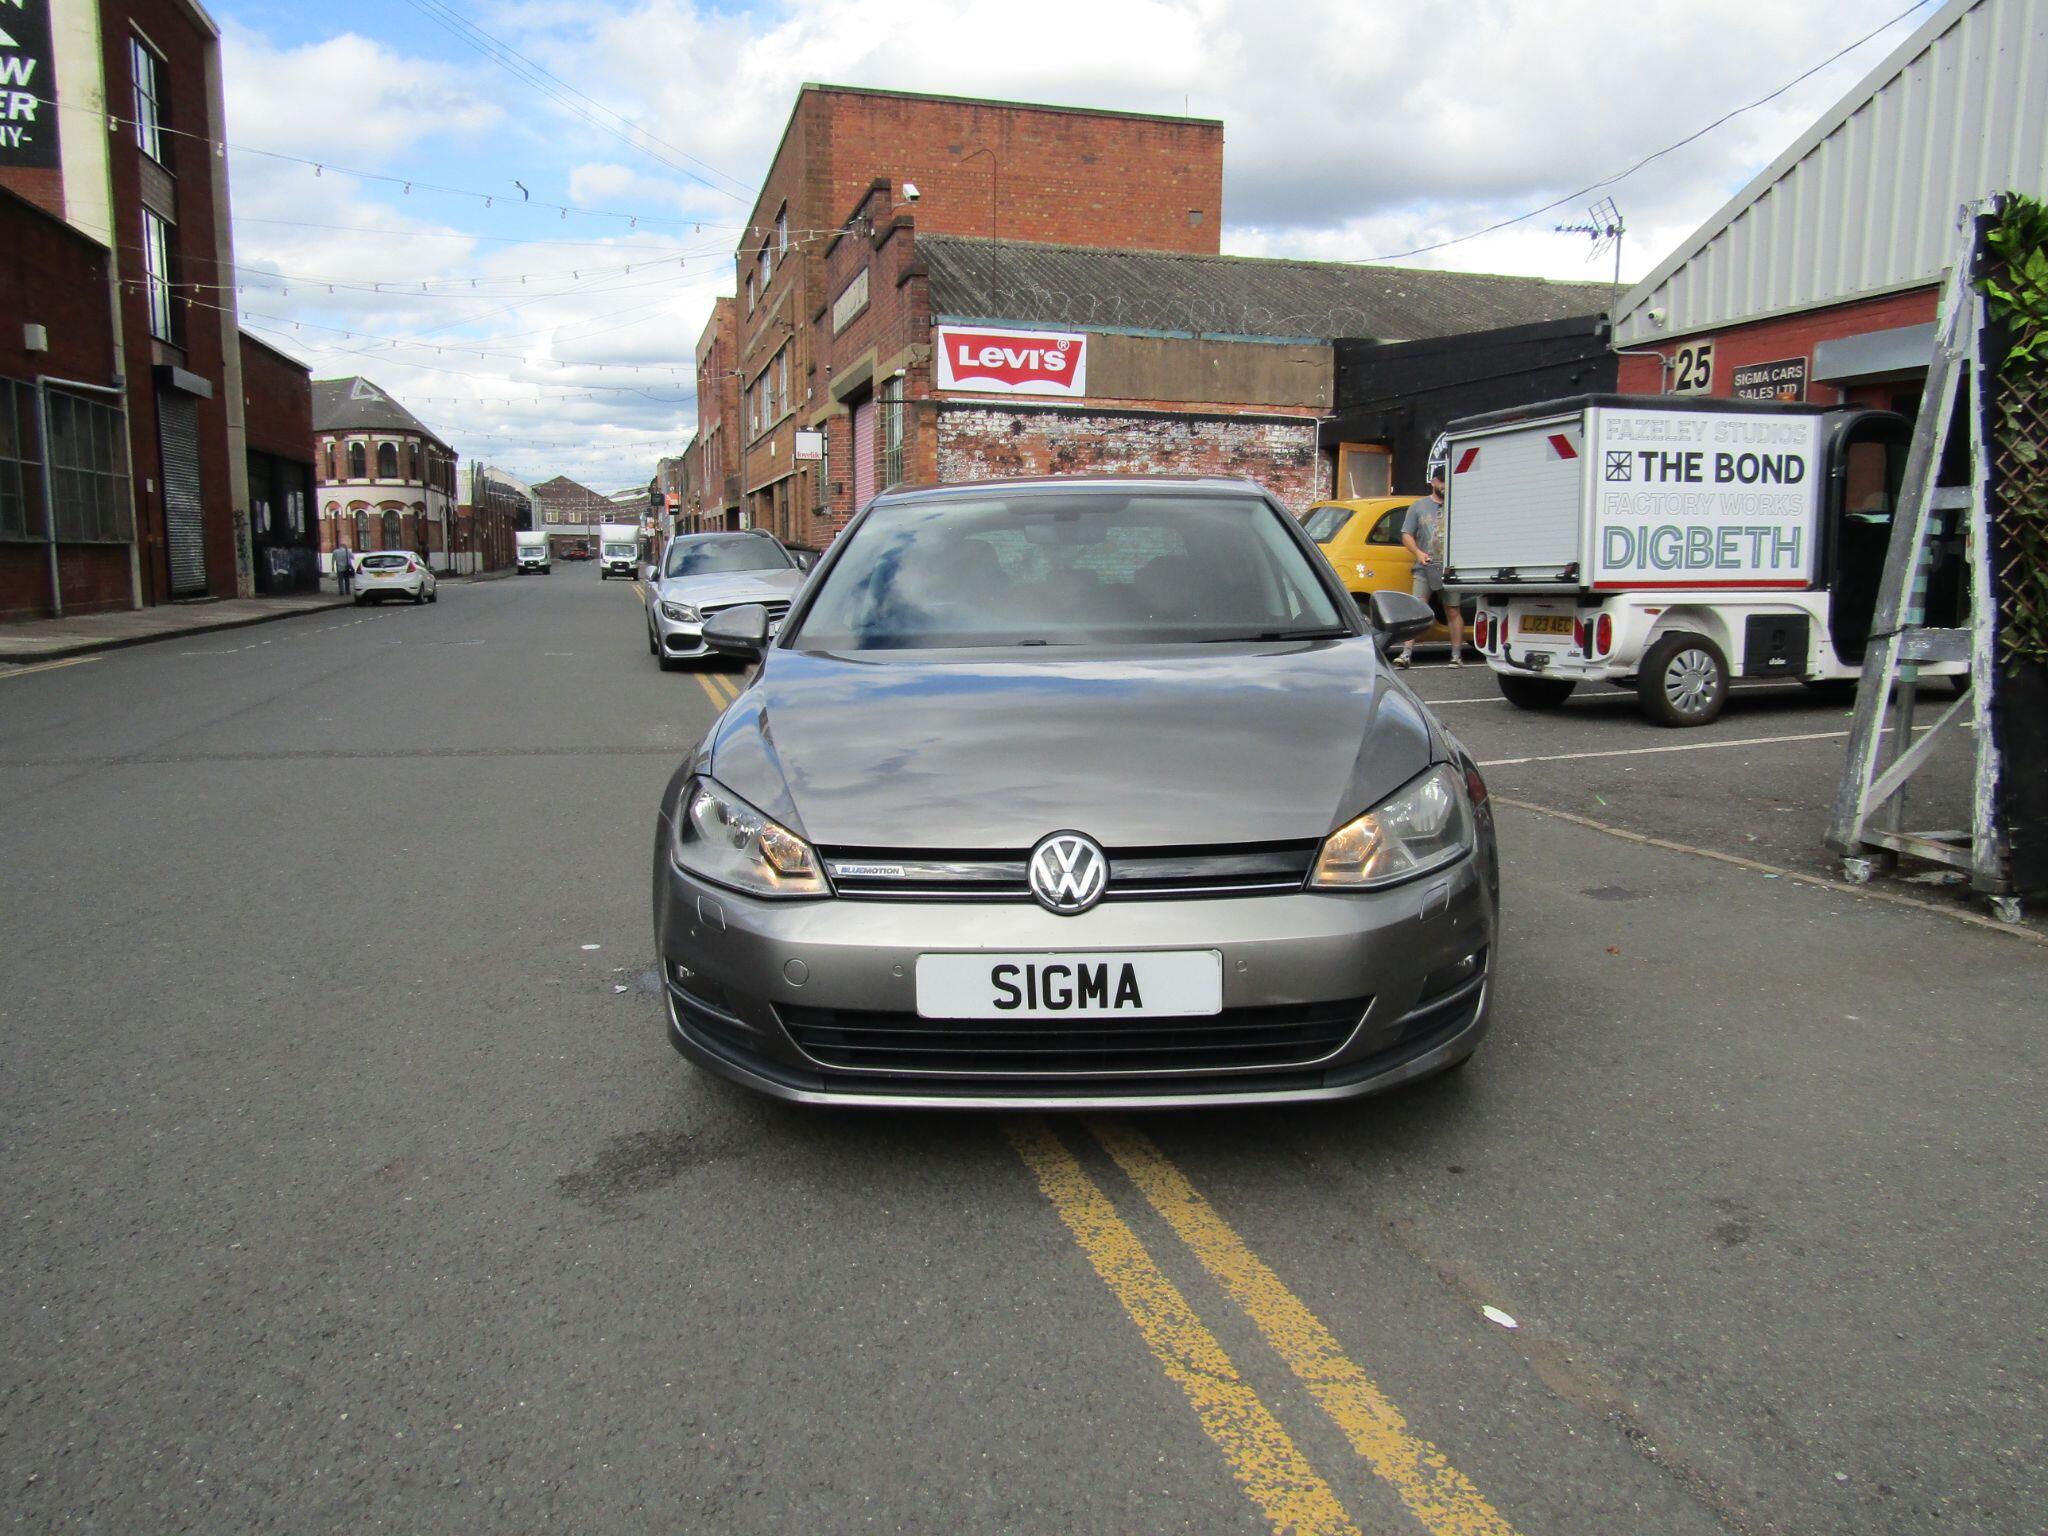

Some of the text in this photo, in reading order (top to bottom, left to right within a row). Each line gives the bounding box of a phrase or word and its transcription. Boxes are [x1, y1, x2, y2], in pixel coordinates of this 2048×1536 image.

[1676, 346, 1712, 391] 25
[1734, 365, 1803, 386] SIGMA CARS
[1739, 386, 1774, 400] SALES
[1606, 418, 1808, 445] FAZELEY STUDIOS
[1637, 451, 1805, 485] THE BOND
[1603, 492, 1804, 516] FACTORY WORKS
[1602, 524, 1802, 571] DIGBETH
[840, 866, 900, 875] BLUEMOTION
[991, 962, 1143, 1010] SIGMA
